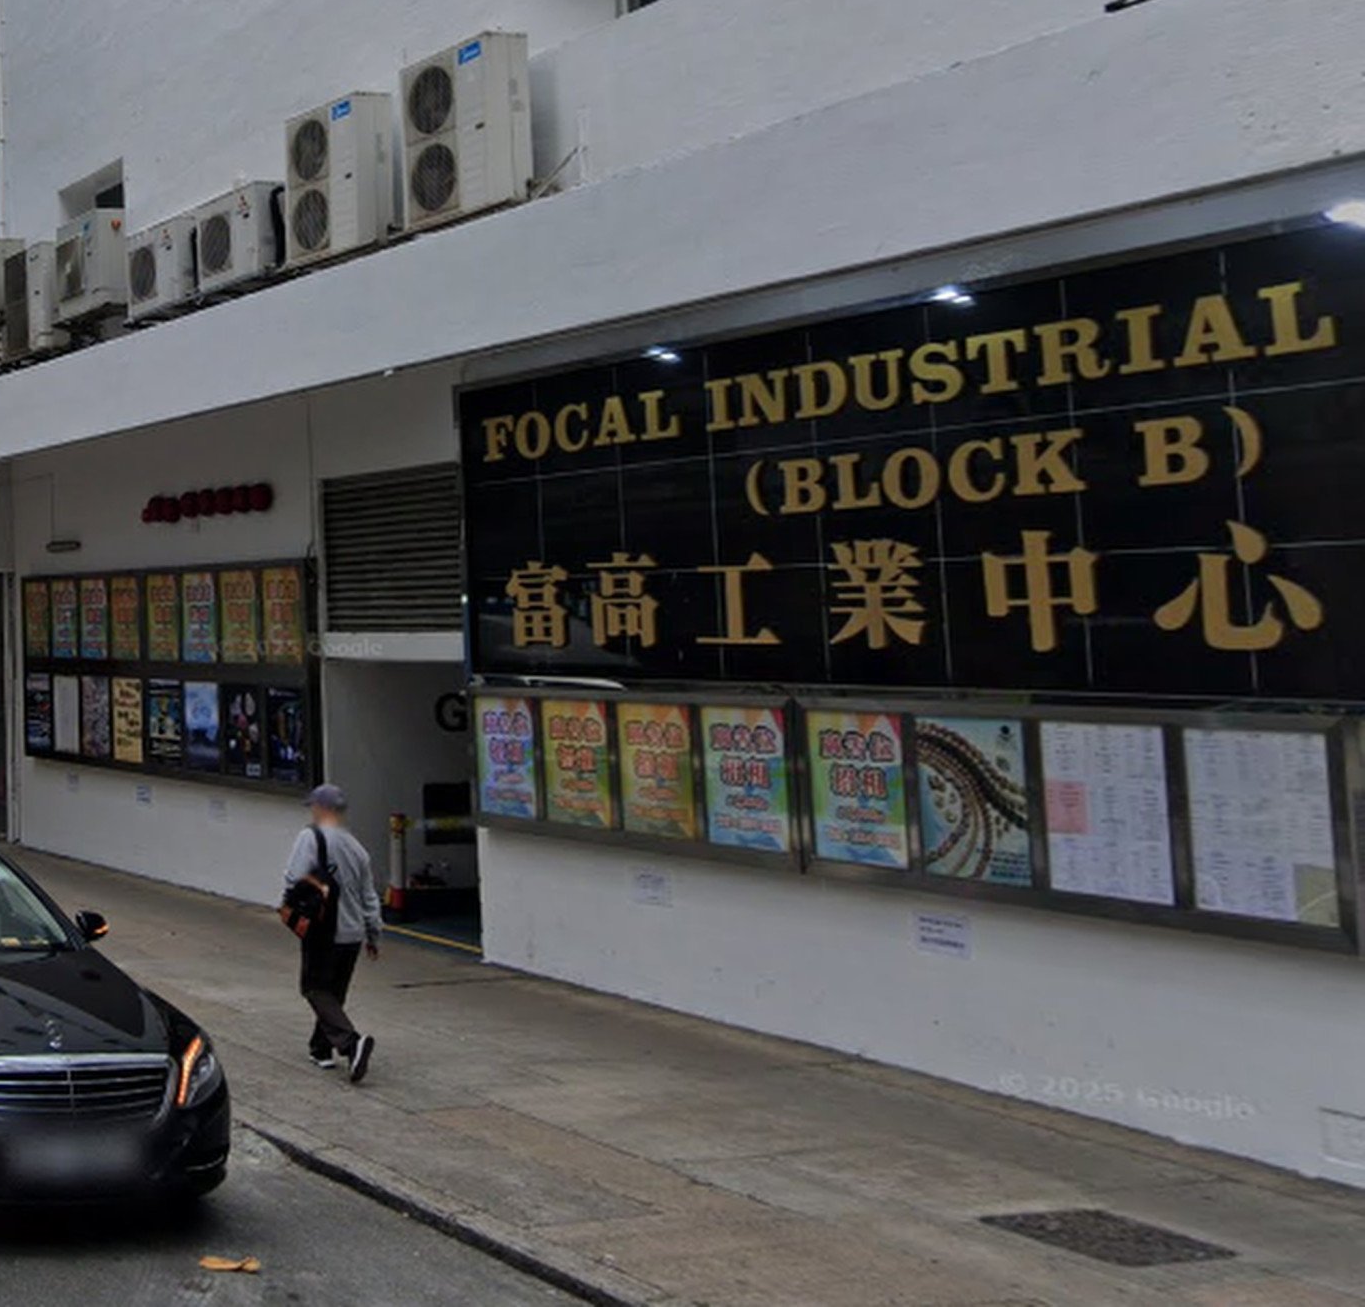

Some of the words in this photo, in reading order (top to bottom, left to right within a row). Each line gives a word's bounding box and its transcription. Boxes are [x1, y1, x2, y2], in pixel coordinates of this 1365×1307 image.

[482, 388, 682, 462] FOCAL
[704, 280, 1338, 434] INDUSTRIAL
[744, 427, 1086, 516] (BLOCK
[1134, 404, 1263, 490] B)
[504, 519, 1325, 654] 富高工業中心
